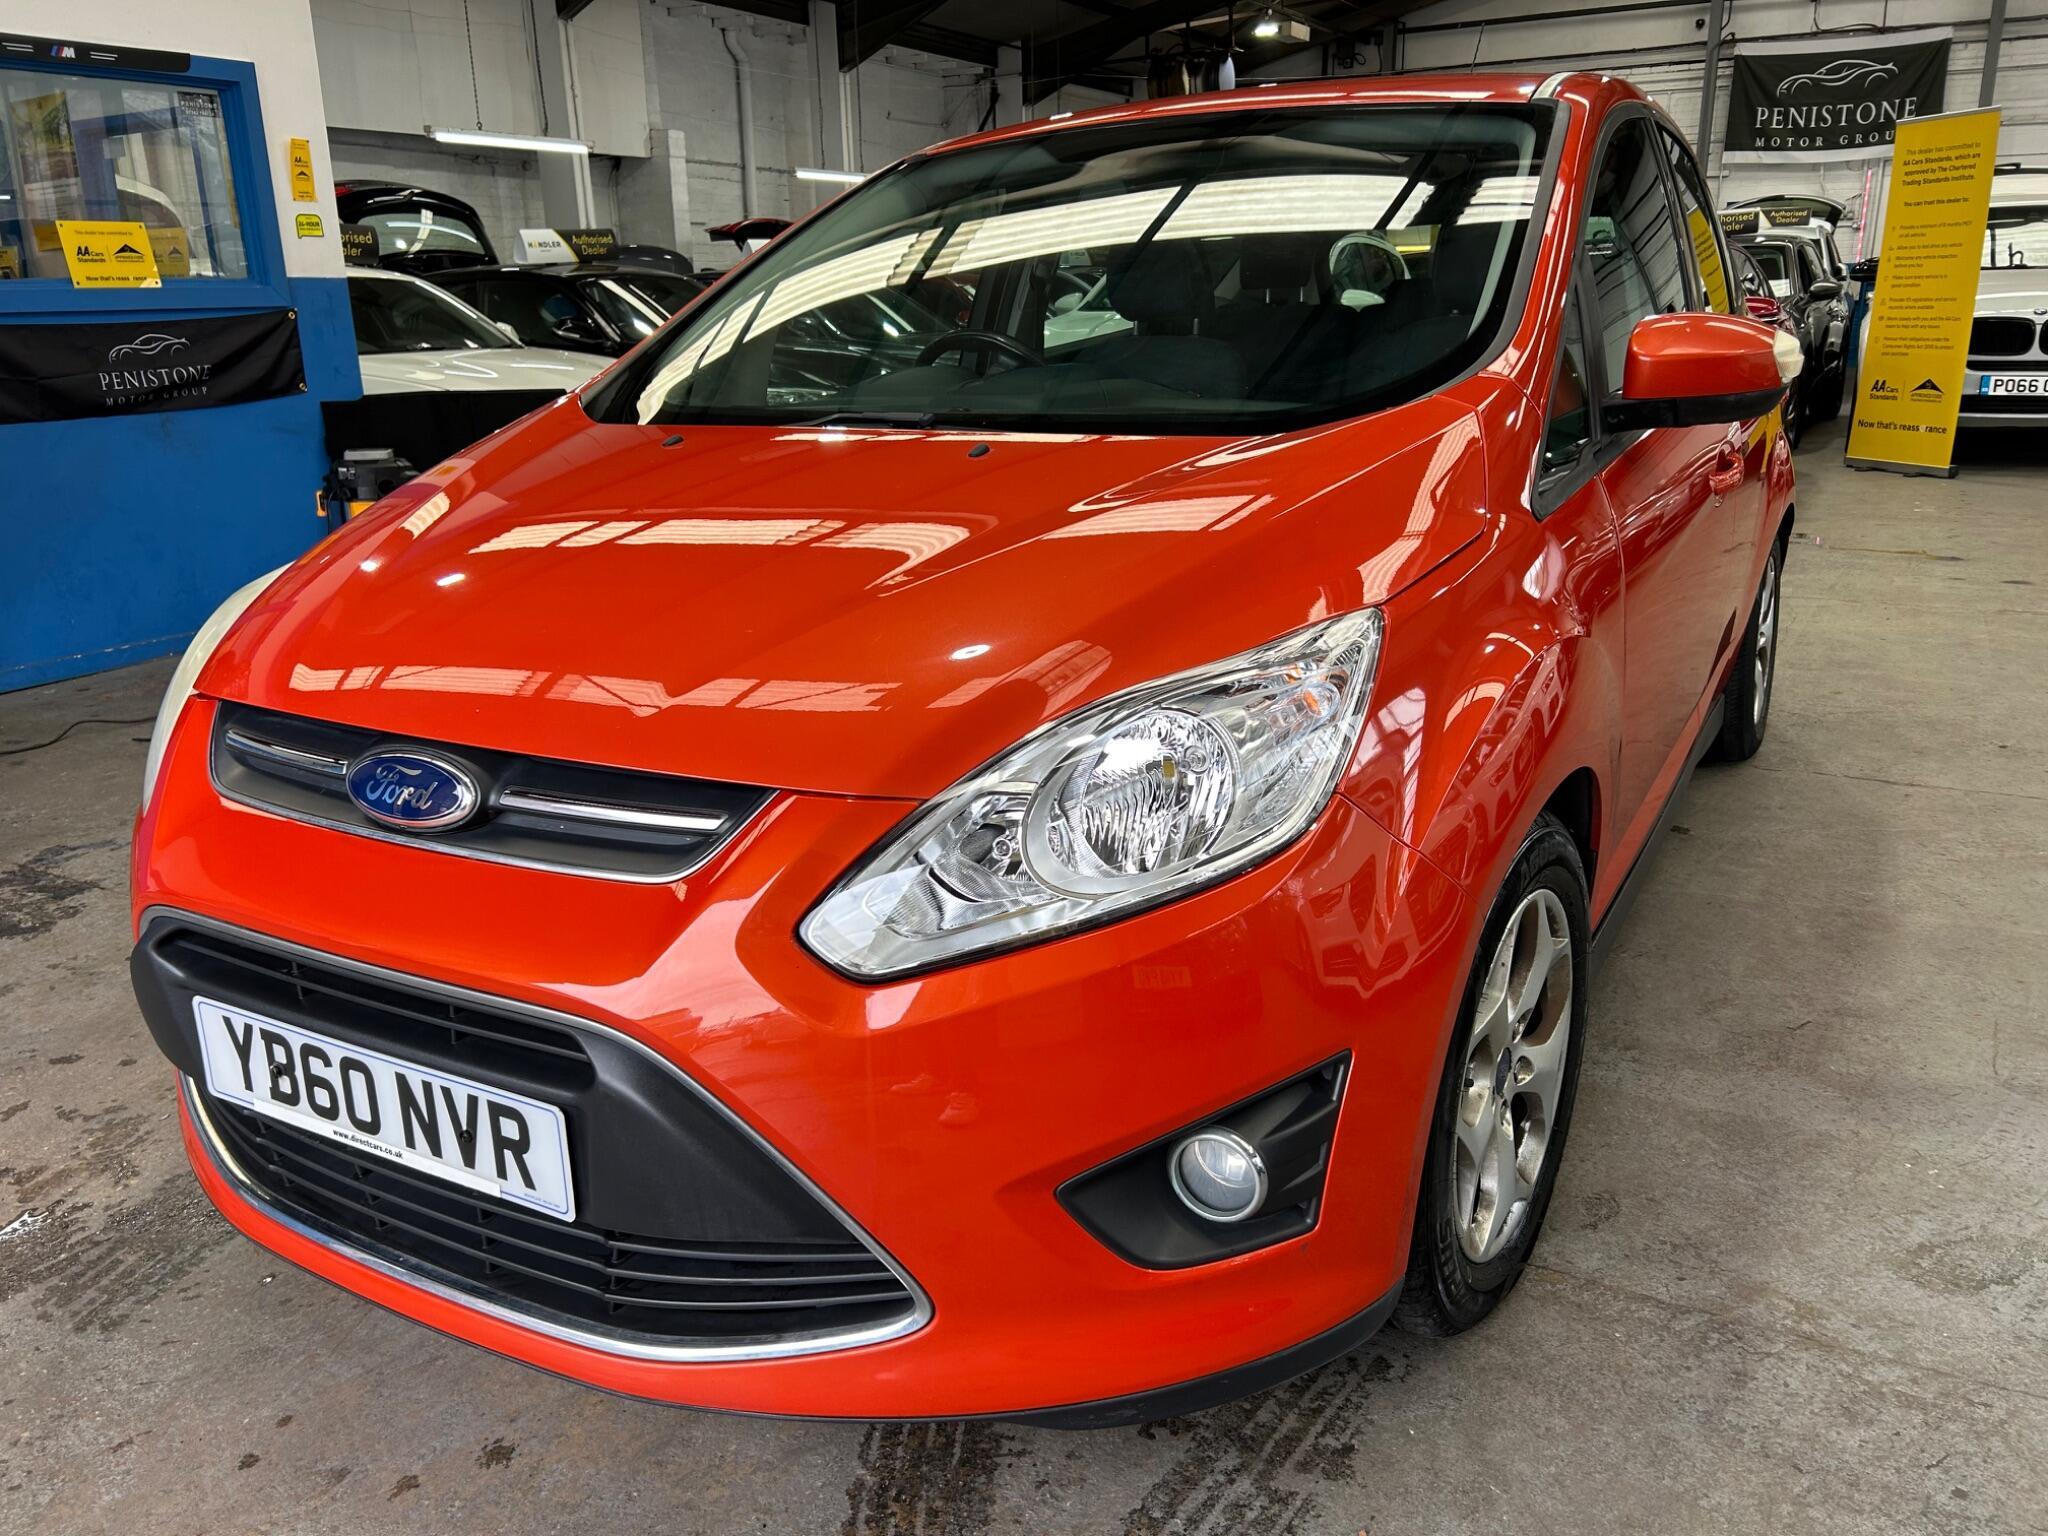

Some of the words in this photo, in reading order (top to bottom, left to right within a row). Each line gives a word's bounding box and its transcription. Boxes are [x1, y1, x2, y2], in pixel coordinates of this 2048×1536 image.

[1755, 97, 1917, 129] PENISTONE
[1755, 137, 1823, 147] MOTOR
[1840, 130, 1895, 145] GROU
[1720, 211, 1754, 223] horised
[1770, 209, 1808, 217] Authorised
[1723, 223, 1744, 231] aler
[340, 231, 373, 244] orised
[572, 233, 613, 244] Authorised
[76, 245, 91, 257] AA
[343, 243, 362, 256] aler
[581, 244, 608, 255] Dealer
[98, 365, 212, 391] PENISTONE
[1871, 379, 1886, 392] AA
[1993, 379, 2040, 393] PO66
[163, 386, 208, 399] GROUP
[1869, 393, 1898, 401] Standards
[1858, 419, 1875, 428] Now
[1876, 420, 1898, 430] that's
[1898, 423, 1947, 434] reassrance
[366, 763, 438, 810] Ford
[222, 1015, 382, 1136] YB60
[394, 1071, 537, 1192] NVR
[333, 1129, 403, 1159] www.directcars.co.uk
